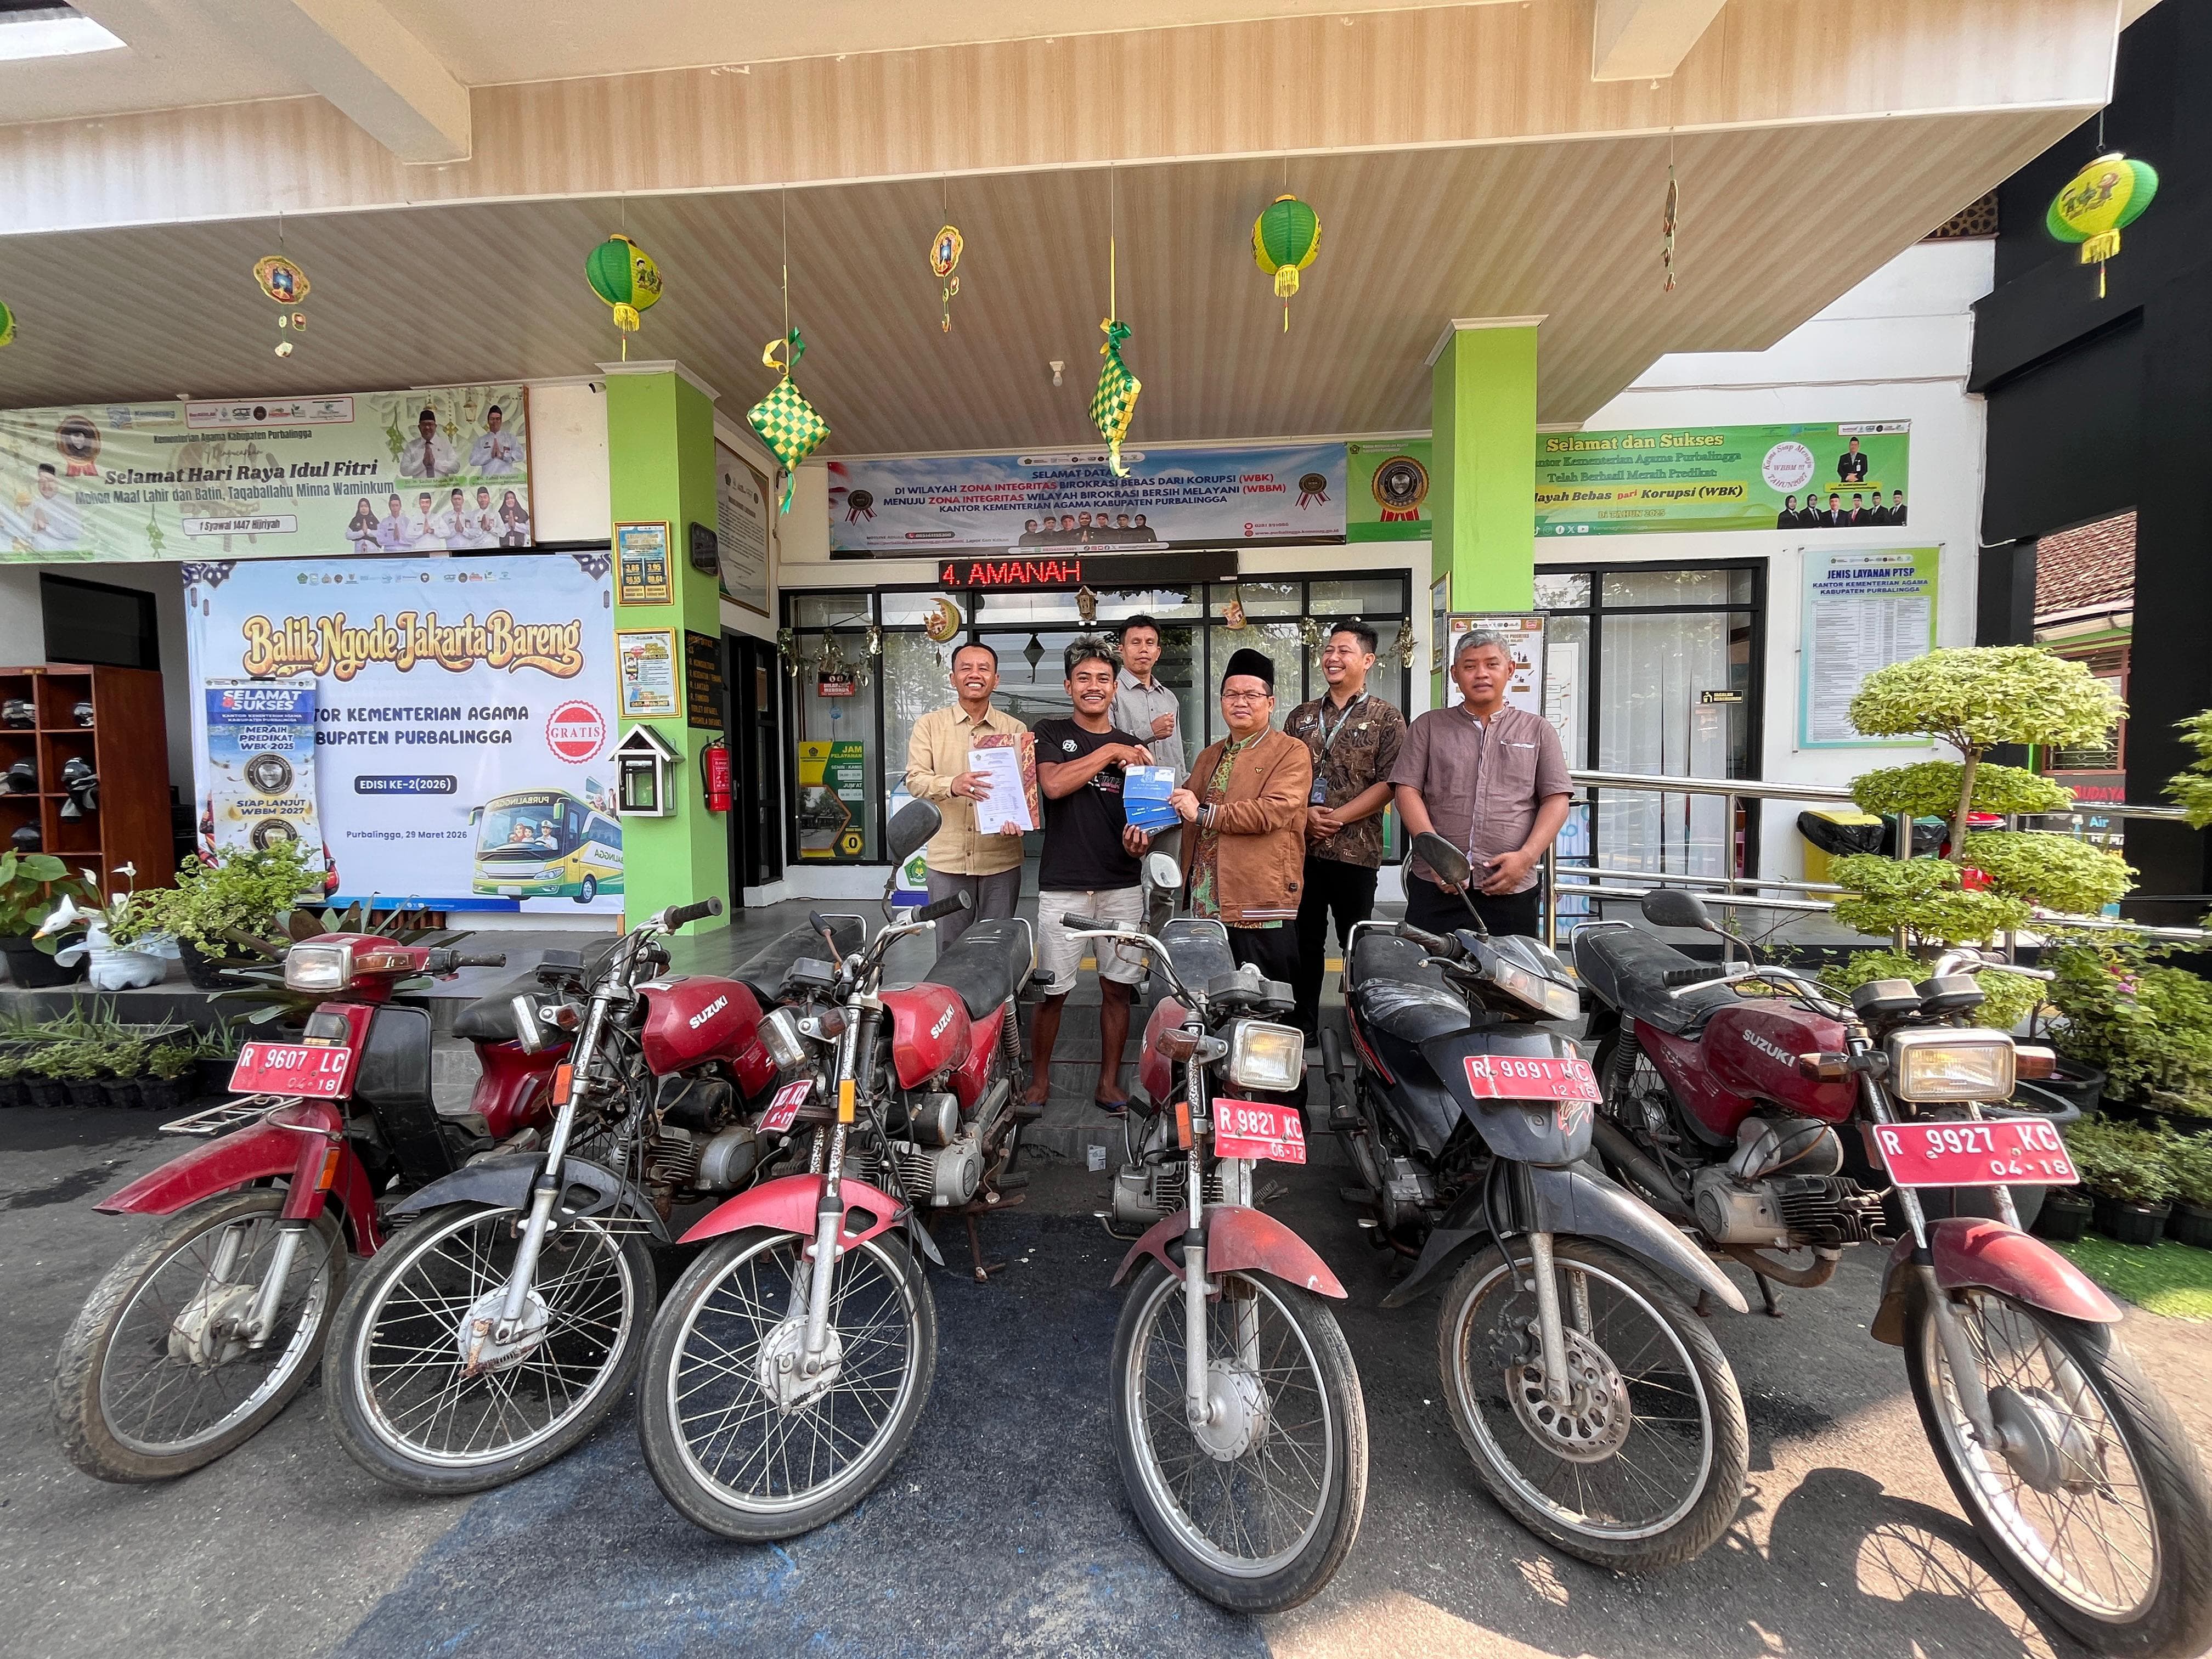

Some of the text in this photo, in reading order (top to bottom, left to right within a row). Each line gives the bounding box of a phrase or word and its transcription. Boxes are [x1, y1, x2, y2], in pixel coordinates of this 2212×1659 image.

[268, 429, 313, 440] Purbalingga
[1546, 433, 1724, 452] Selamat dan Sukses
[1635, 454, 1674, 466] Agama
[1675, 451, 1742, 463] Purbalingga
[104, 459, 379, 484] Selamat Hari Raya Idul Fitri
[1032, 469, 1114, 479] SELAMAT DATA
[1547, 472, 1578, 483] Telah
[143, 488, 169, 503] Lahir
[172, 488, 192, 501] dan
[195, 486, 226, 501] Batin,
[228, 485, 294, 501] Taqaballahu
[296, 483, 330, 497] Minna
[332, 481, 395, 496] Waminkum
[907, 485, 957, 494] WILAYAH
[960, 483, 992, 493] ZONA
[994, 482, 1057, 492] INTEGRITAS
[1059, 479, 1119, 489] BIROKRASI
[1121, 477, 1155, 487] BEBAS
[1158, 476, 1184, 485] DARI
[1187, 475, 1236, 484] KORUPSI
[1239, 473, 1274, 483] (WBK)
[883, 483, 1286, 506] MENUJU ZONA INTEGRITAS WILAYAH BIROKRASI BERSIH MELAYANI (WBBM)
[1535, 484, 1743, 504] layah Bebas Dari Korupsi (WBK)
[939, 495, 1228, 513] KANTOR KEMENTERIAN AGAMA KABUPATEN PURBALINGGA
[1598, 511, 1608, 519] Di
[1610, 510, 1643, 518] TAHUN
[234, 520, 250, 530] 1447
[943, 560, 1080, 585] 4. AMANAH
[1827, 568, 1915, 579] JENIS LAYANAN PTSP
[243, 610, 585, 682] Balik Ngode Jakarta Bareng
[223, 690, 302, 701] SELAMAT
[231, 701, 295, 711] SUKSES
[347, 707, 462, 722] KEMENTERIAN
[467, 706, 529, 721] AGAMA
[315, 730, 512, 746] BUPATEN PURBALINGGA
[551, 726, 601, 738] GRATIS
[359, 778, 452, 791] EDISI KE-2(2026)
[2089, 815, 2109, 827] Air
[346, 830, 404, 840] Purbalingga,
[405, 831, 416, 839] 29
[418, 831, 444, 839] Maret
[689, 995, 729, 1030] SUZUKI
[930, 1003, 955, 1040] SUZUKI
[1742, 1029, 1796, 1068] SUZUKI
[241, 1048, 346, 1073] R 9607 LC
[1471, 1060, 1486, 1078] R
[1500, 1060, 1552, 1080] 9891
[1220, 1106, 1232, 1131] R
[1237, 1108, 1276, 1136] 9821
[1881, 1124, 2058, 1155] R 9927 KC
